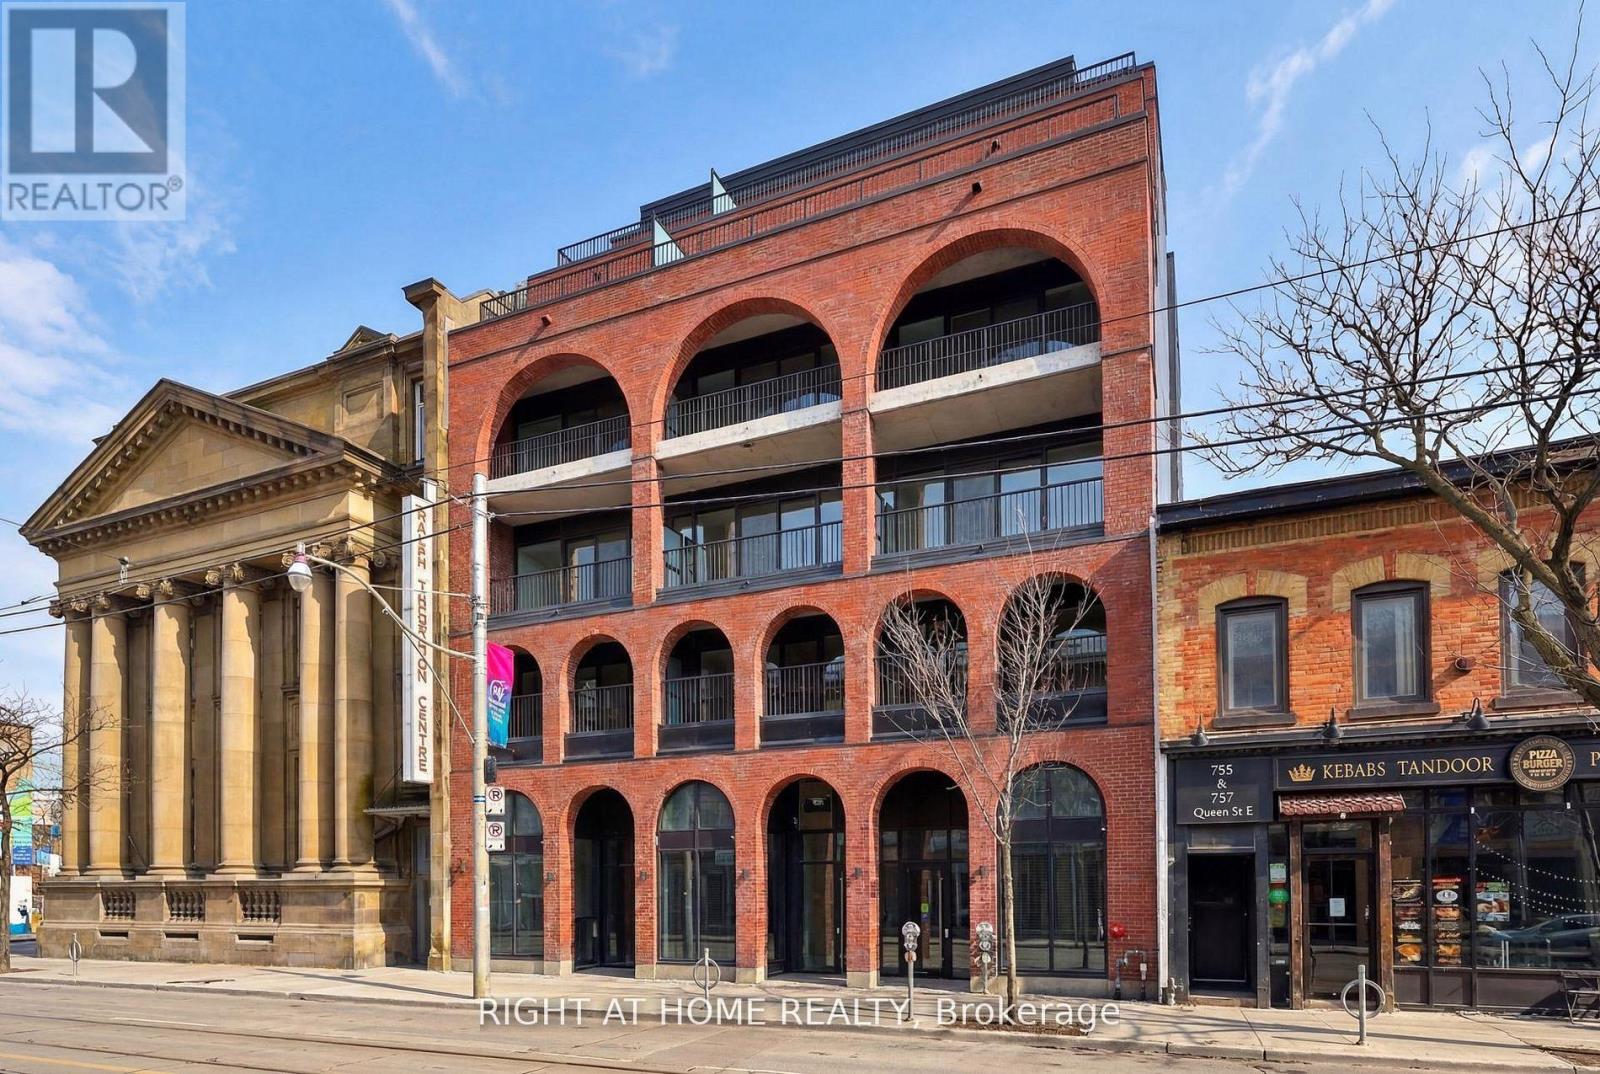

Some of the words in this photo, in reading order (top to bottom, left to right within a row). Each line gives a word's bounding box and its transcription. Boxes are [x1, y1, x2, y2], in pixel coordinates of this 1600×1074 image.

[418, 695, 427, 772] CENTRE
[1528, 749, 1558, 759] PIZZA
[1323, 761, 1387, 779] KEBABS
[1397, 756, 1495, 776] TANDOOR
[1522, 758, 1563, 769] BURGER
[1210, 764, 1234, 776] 755
[1217, 778, 1227, 789] &
[1210, 791, 1234, 804] 757
[1193, 807, 1229, 820] Queen
[1232, 806, 1243, 816] St
[1246, 805, 1254, 816] E
